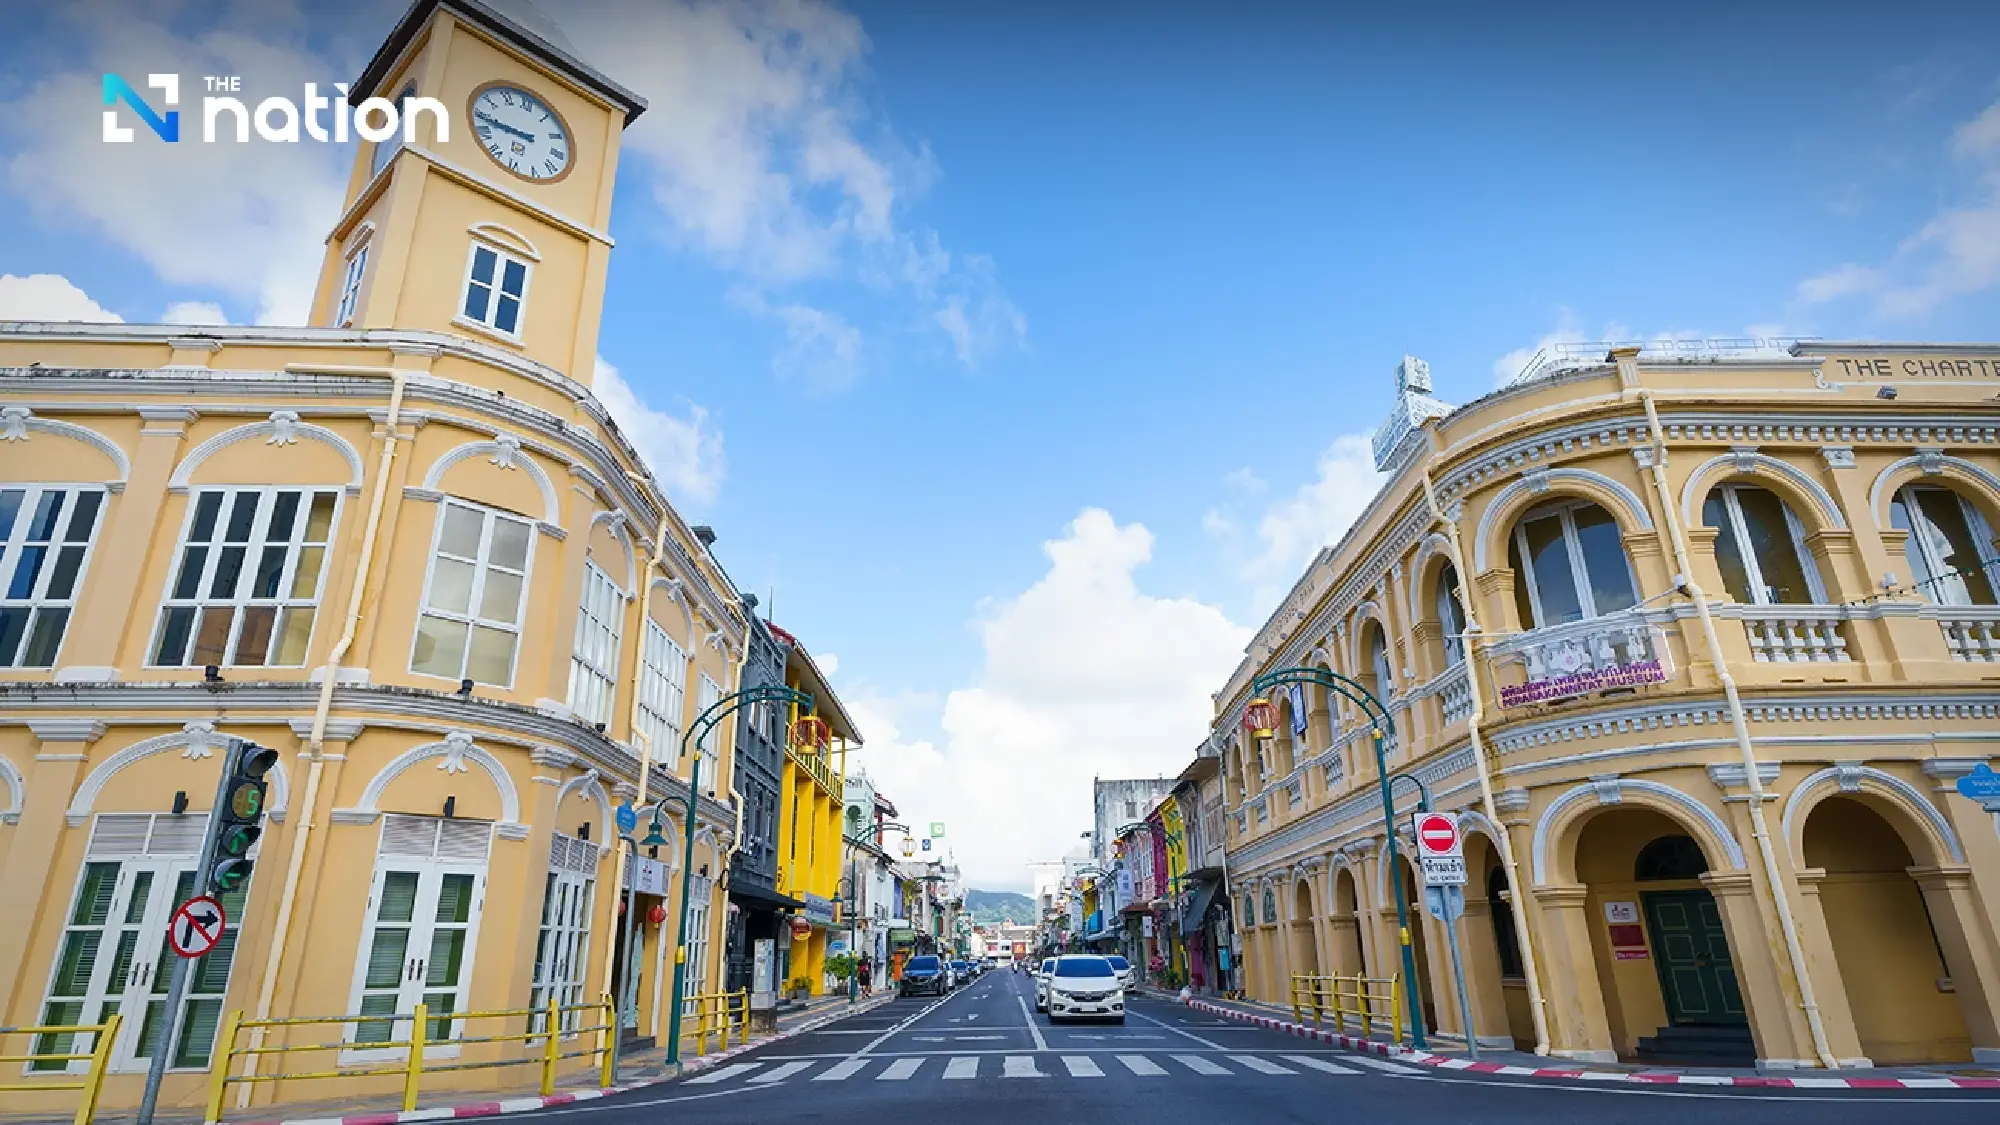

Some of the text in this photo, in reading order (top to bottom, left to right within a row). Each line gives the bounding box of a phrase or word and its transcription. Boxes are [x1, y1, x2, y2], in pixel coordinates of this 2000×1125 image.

[1837, 359, 1893, 377] THE
[1607, 672, 1665, 686] MUSEUM
[246, 789, 258, 815] 5
